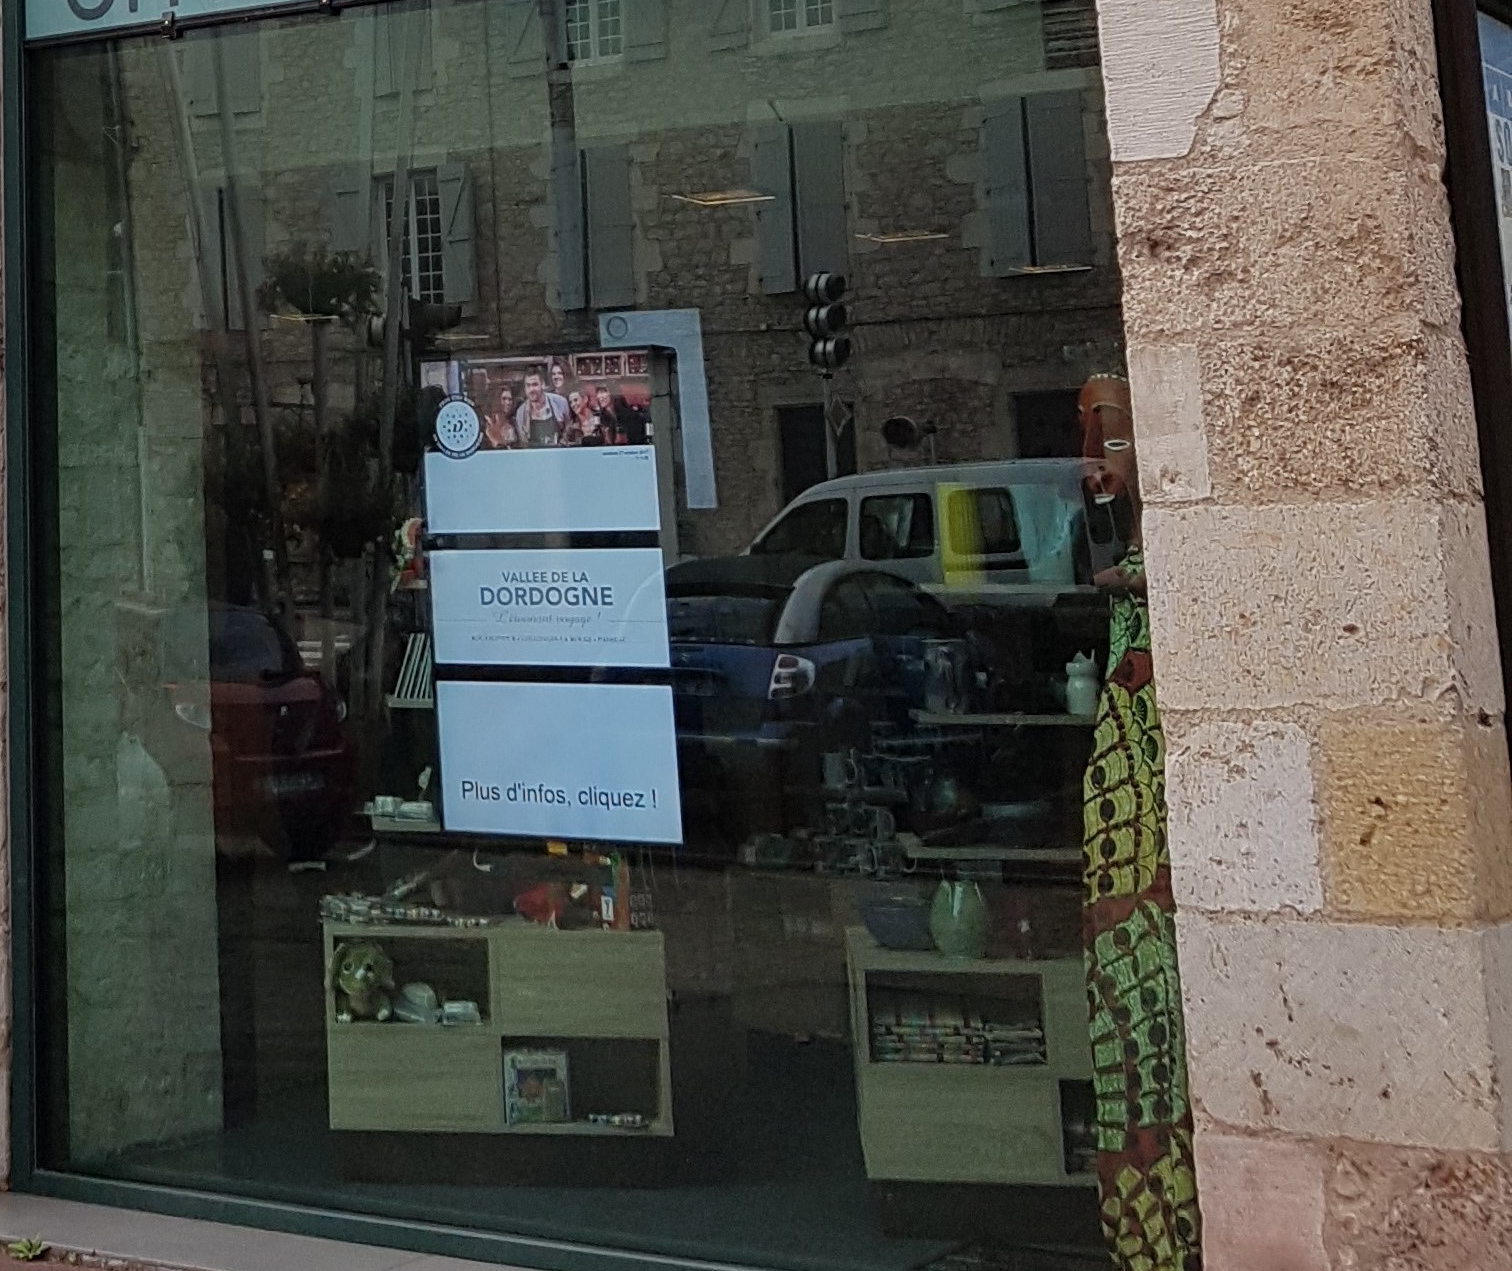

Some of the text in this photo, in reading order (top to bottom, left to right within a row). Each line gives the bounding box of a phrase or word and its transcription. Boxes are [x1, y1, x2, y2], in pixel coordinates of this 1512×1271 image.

[551, 571, 569, 583] DE
[572, 571, 590, 583] LA
[479, 586, 614, 606] DORDOGNE
[460, 780, 657, 811] Plus d'infos, cliquez !
